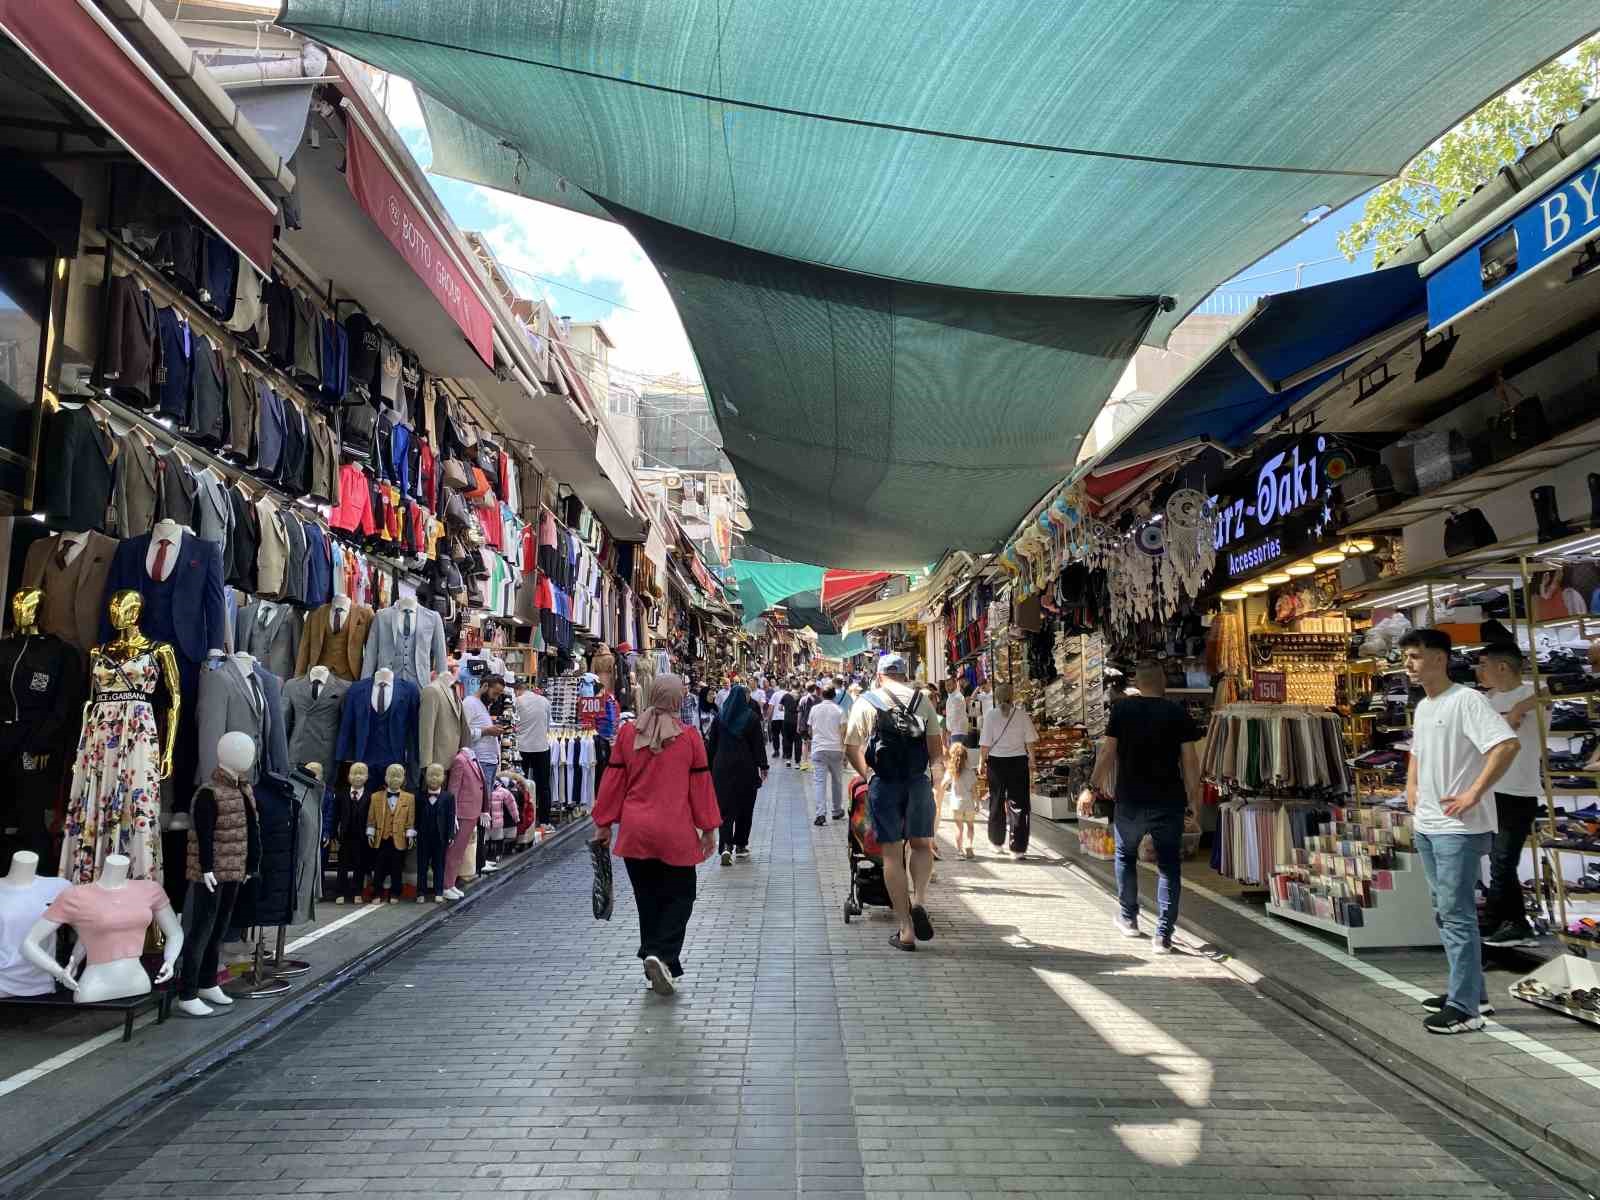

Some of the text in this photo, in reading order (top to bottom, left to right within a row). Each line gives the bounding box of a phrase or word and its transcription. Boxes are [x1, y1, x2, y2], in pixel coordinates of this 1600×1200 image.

[402, 213, 432, 269] BOTTO
[1229, 536, 1281, 576] Accessories
[582, 698, 601, 713] 200
